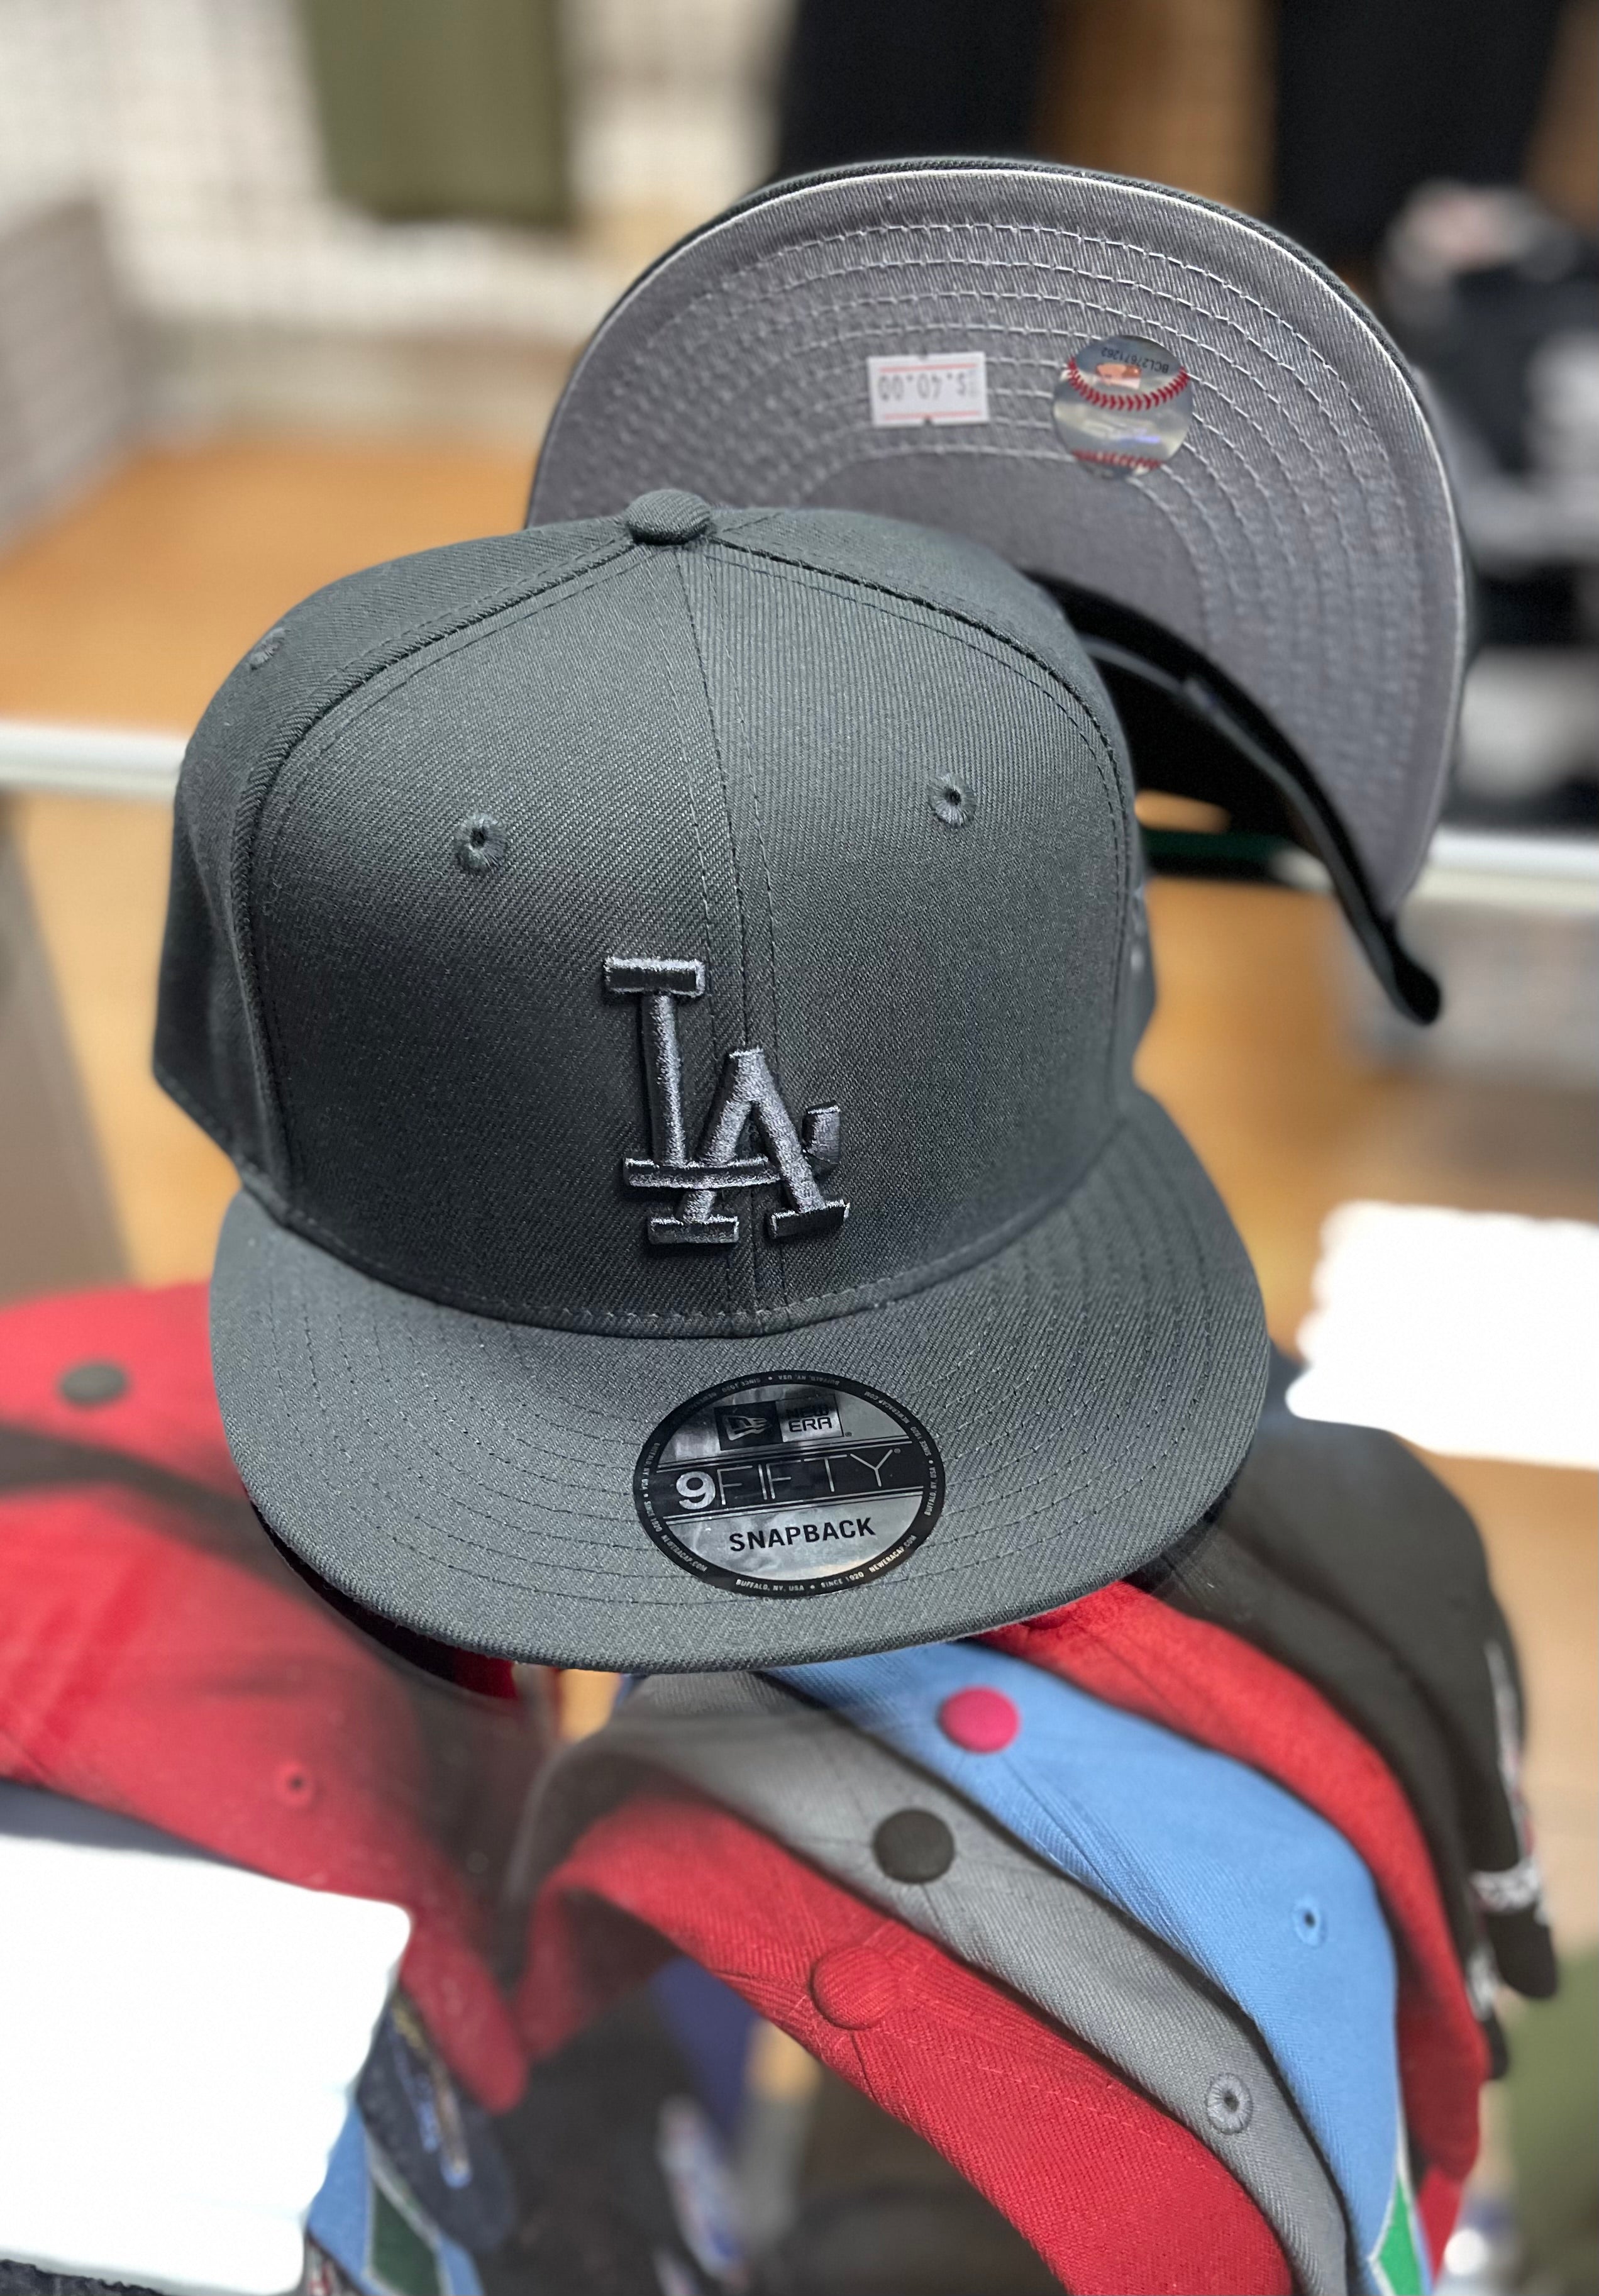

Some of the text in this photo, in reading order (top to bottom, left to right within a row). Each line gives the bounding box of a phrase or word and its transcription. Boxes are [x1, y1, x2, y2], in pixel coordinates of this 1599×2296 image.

[604, 955, 850, 1245] LA
[788, 1416, 833, 1433] ERA
[676, 1449, 893, 1509] 9FIFTY
[729, 1517, 876, 1552] SNAPBACK
[821, 1579, 843, 1588] SINCE
